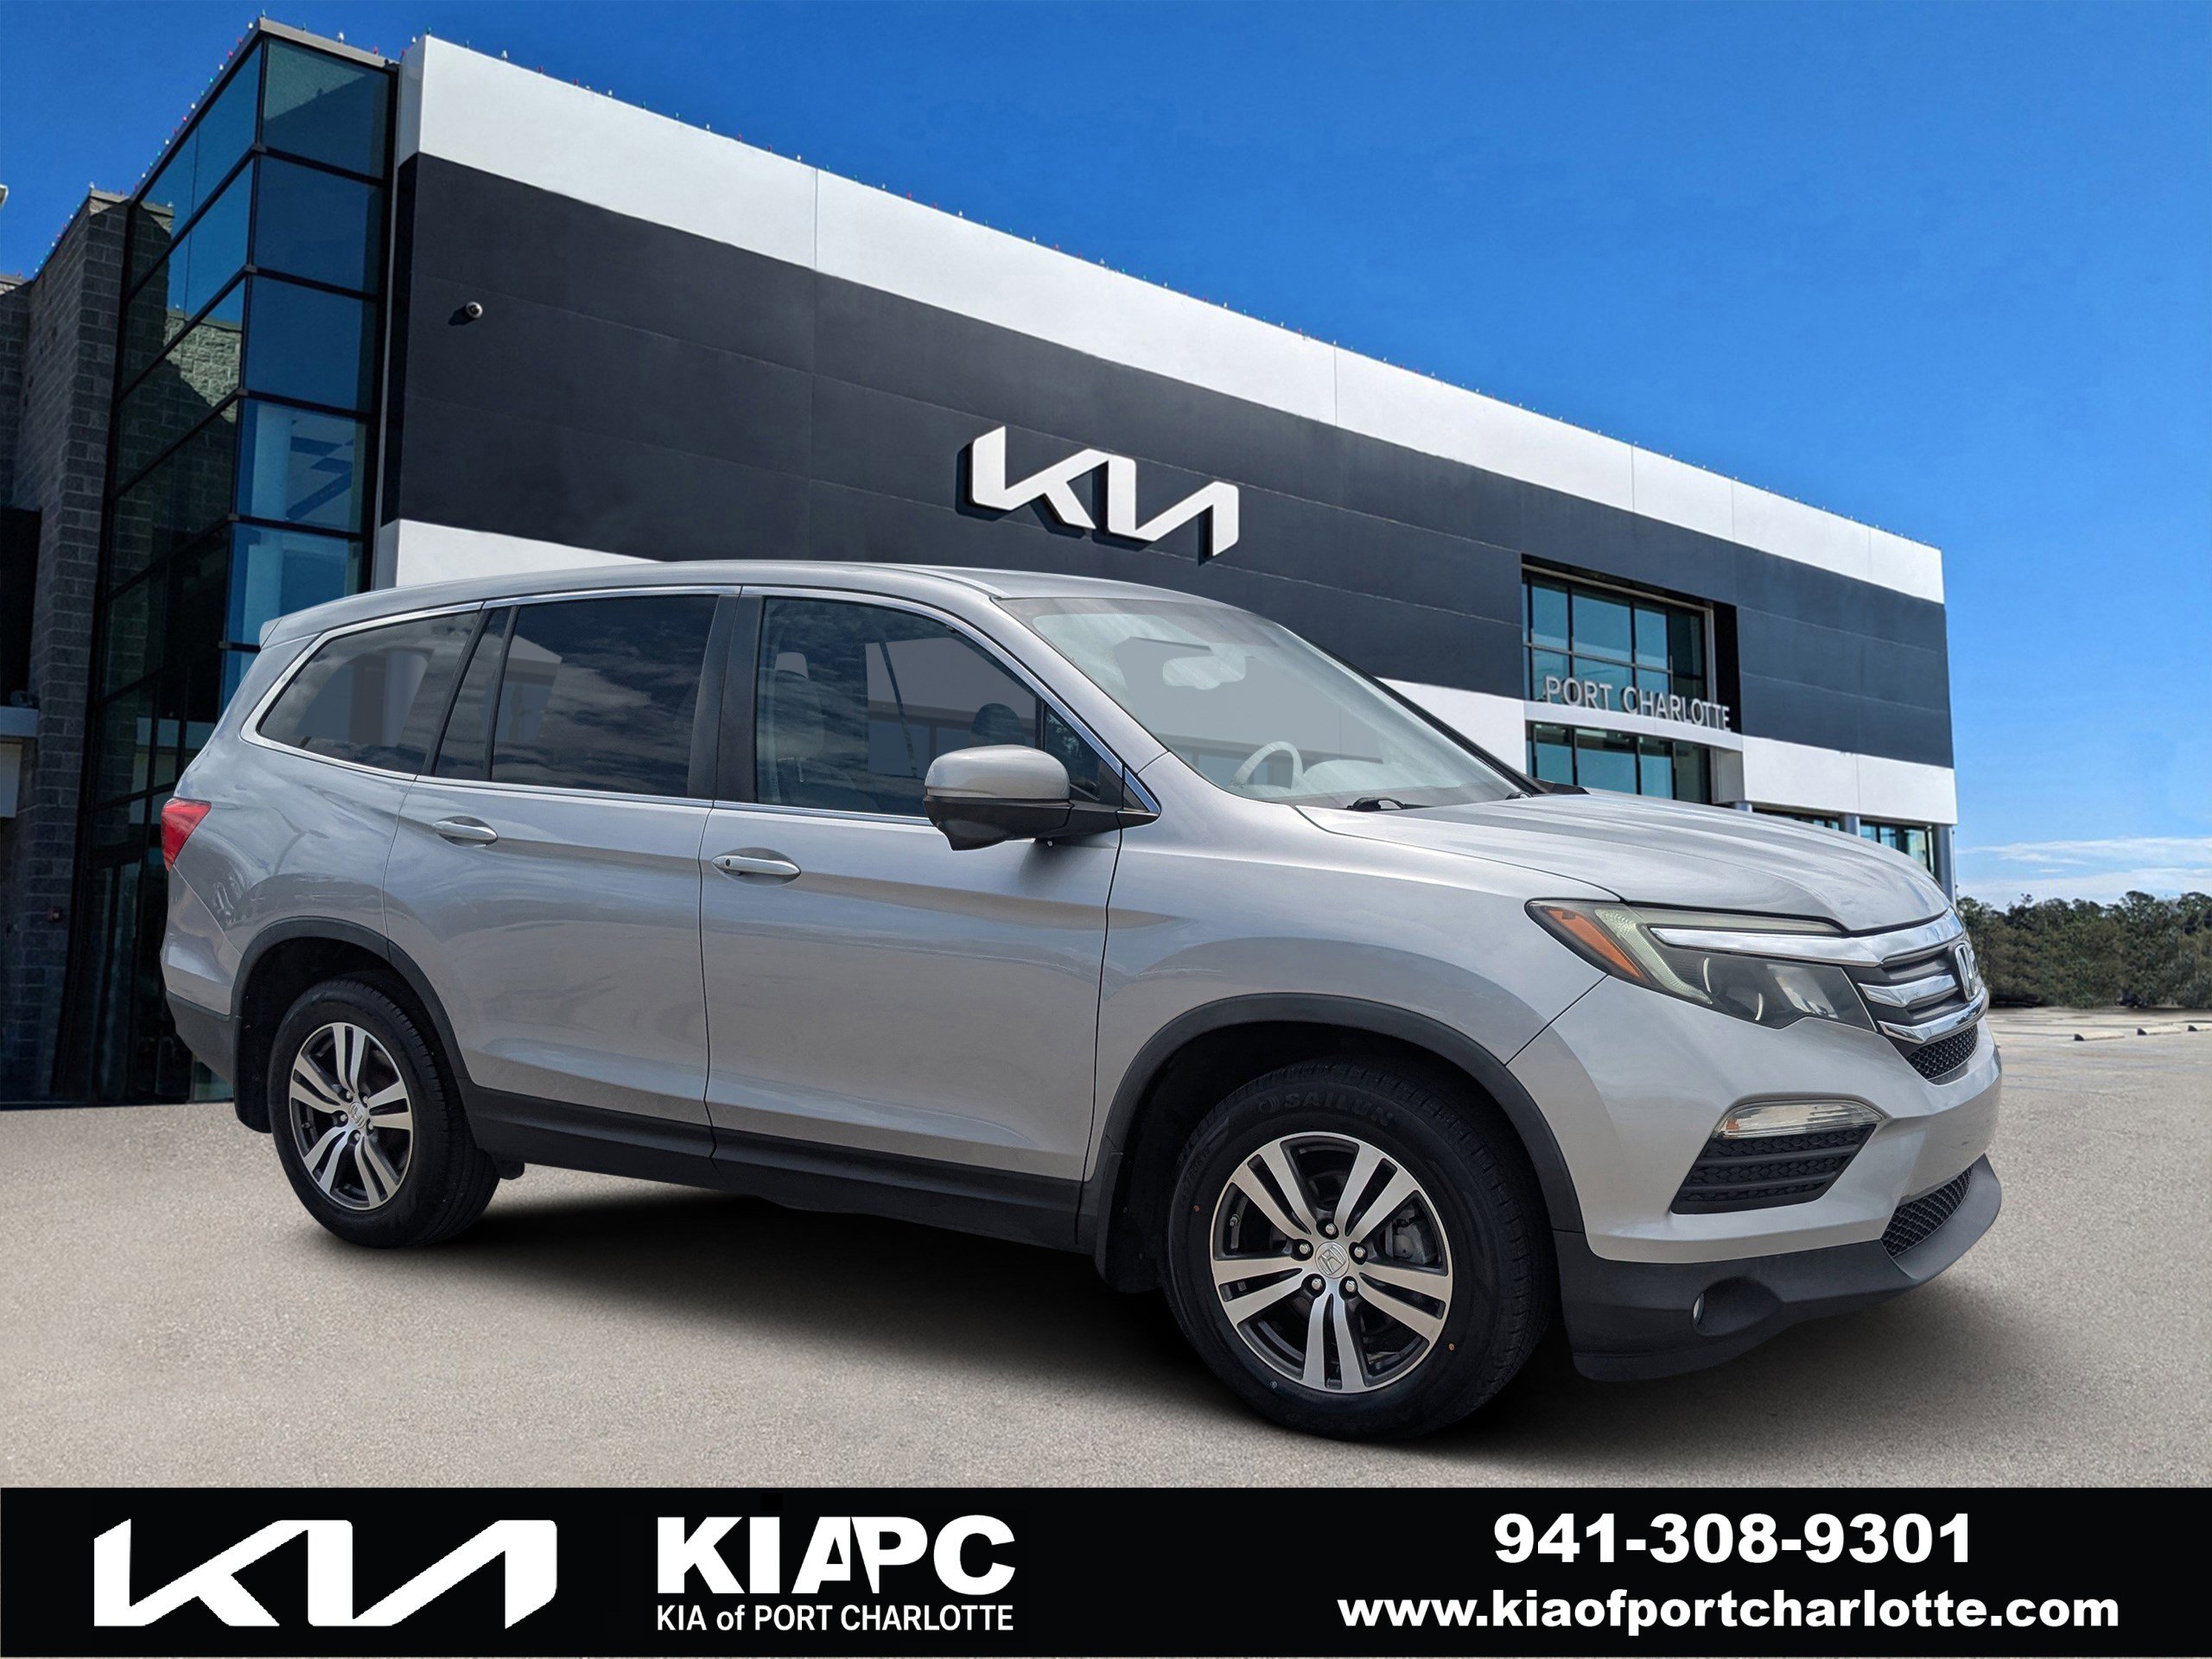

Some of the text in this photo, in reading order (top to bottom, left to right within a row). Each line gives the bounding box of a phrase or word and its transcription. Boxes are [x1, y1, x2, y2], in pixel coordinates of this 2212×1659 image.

[972, 425, 1239, 557] KIA
[1544, 676, 1732, 732] PORT CHARLOTTE
